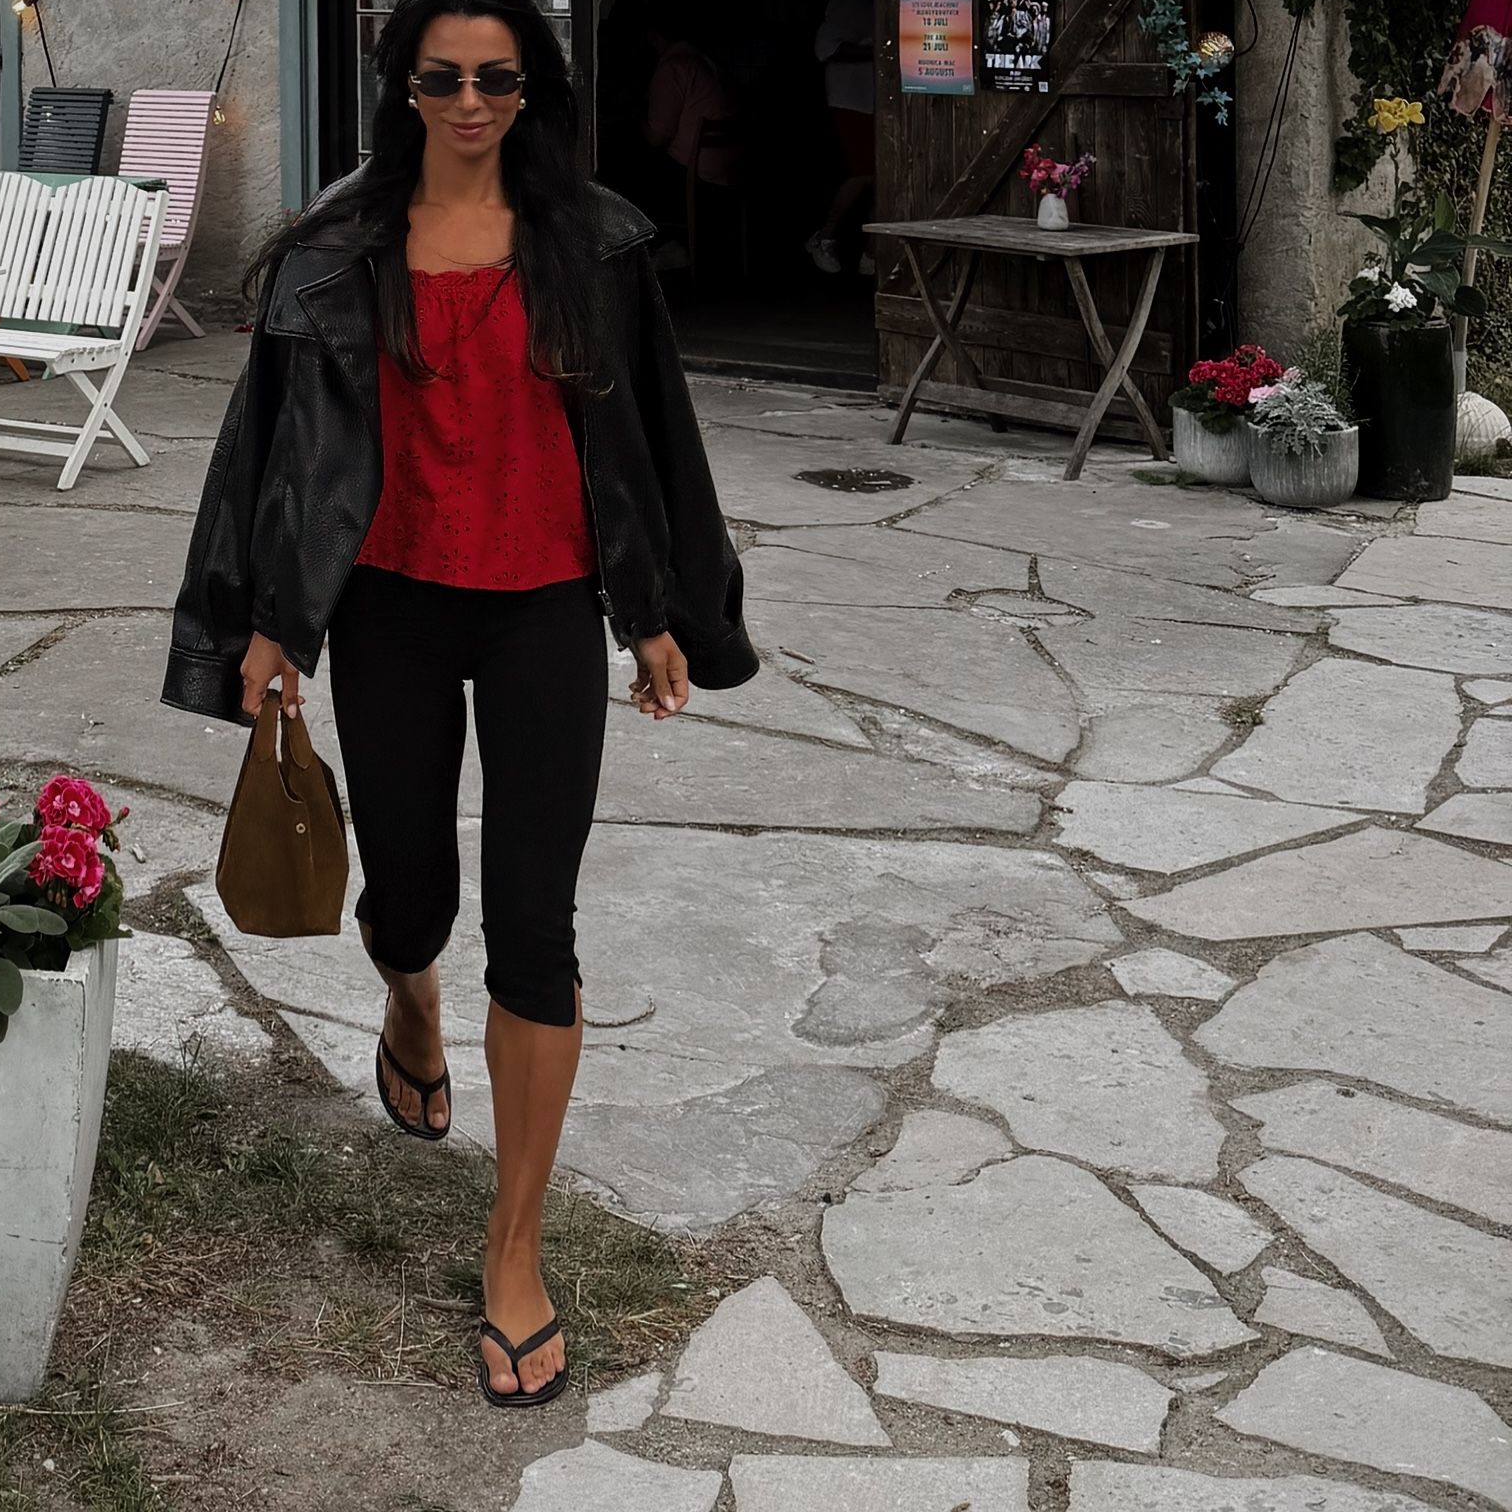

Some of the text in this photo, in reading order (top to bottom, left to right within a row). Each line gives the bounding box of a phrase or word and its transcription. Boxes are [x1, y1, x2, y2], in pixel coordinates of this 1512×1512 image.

[934, 17, 948, 26] JULI
[923, 42, 949, 51] 21 JULI
[985, 53, 1043, 70] THE ARK
[918, 67, 954, 77] 5 AUGUSTI
